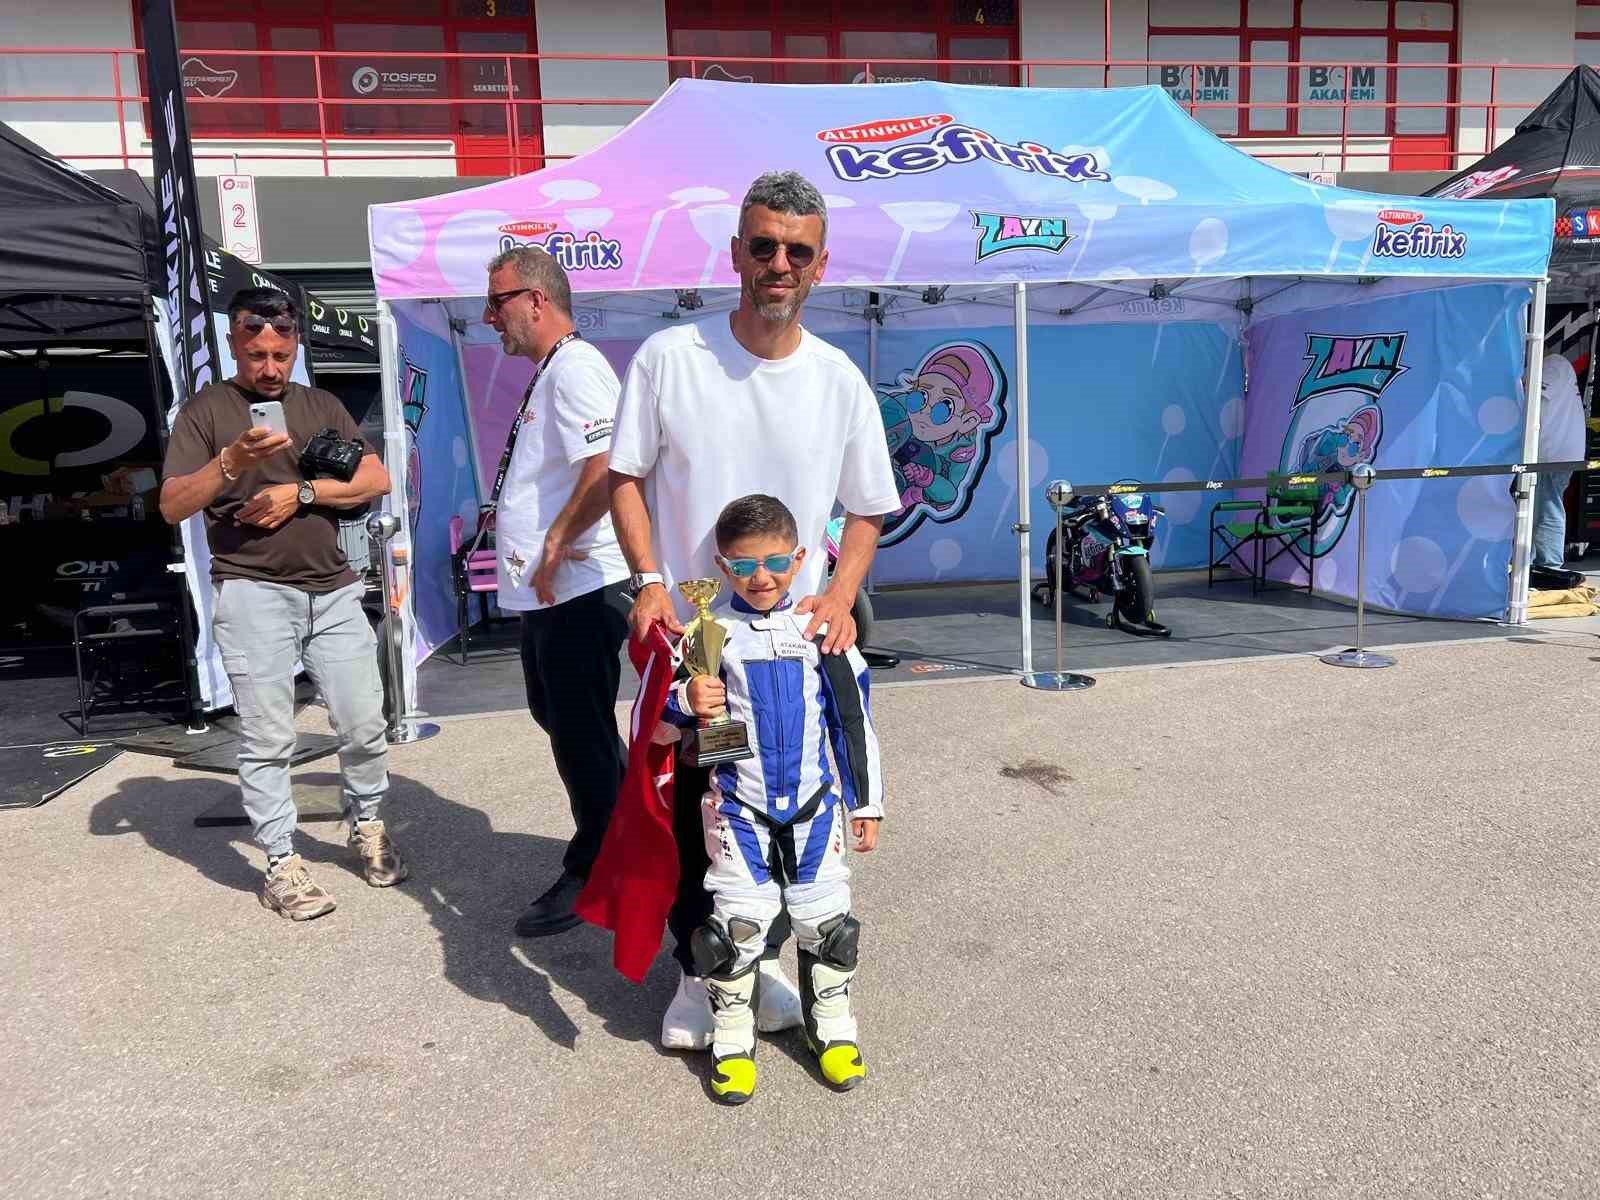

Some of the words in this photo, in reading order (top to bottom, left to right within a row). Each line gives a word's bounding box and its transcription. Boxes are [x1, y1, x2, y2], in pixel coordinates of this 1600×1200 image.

[381, 72, 437, 82] TOSFED
[820, 116, 945, 141] ALTINKILIÇ
[826, 124, 1111, 181] kefirix
[232, 203, 247, 227] 2
[968, 210, 1077, 264] ZAYN
[1373, 224, 1466, 257] kefirix
[1289, 330, 1411, 414] ZAYN
